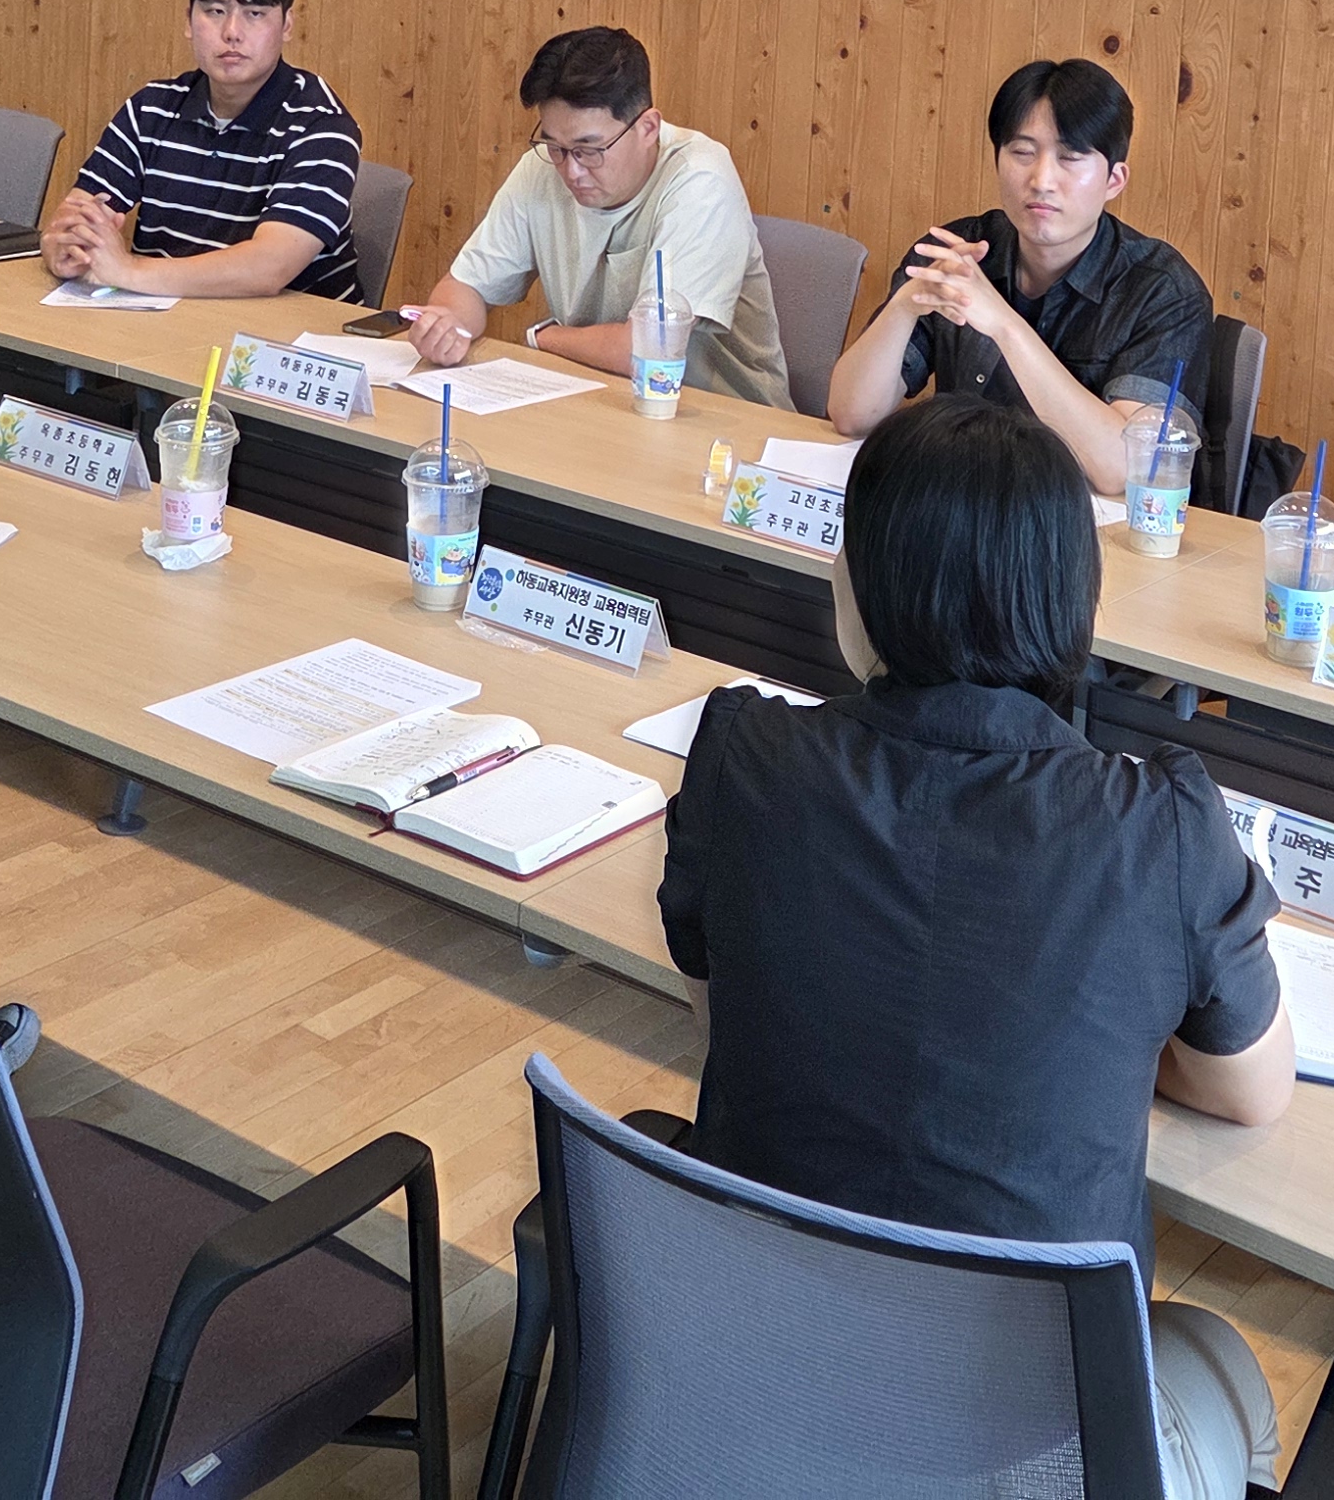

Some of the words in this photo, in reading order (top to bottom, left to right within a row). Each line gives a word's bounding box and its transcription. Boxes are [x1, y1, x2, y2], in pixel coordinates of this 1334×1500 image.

[280, 356, 338, 382] 하동유치원
[255, 375, 289, 395] 주무관
[296, 380, 350, 411] 김동국
[19, 445, 55, 468] 주무관
[64, 453, 122, 489] 김동현
[766, 512, 809, 537] 주무관
[516, 569, 592, 607] 하동교육지원청
[593, 594, 652, 627] 교육협력팀
[522, 607, 555, 630] 주무관
[565, 613, 626, 654] 신동기
